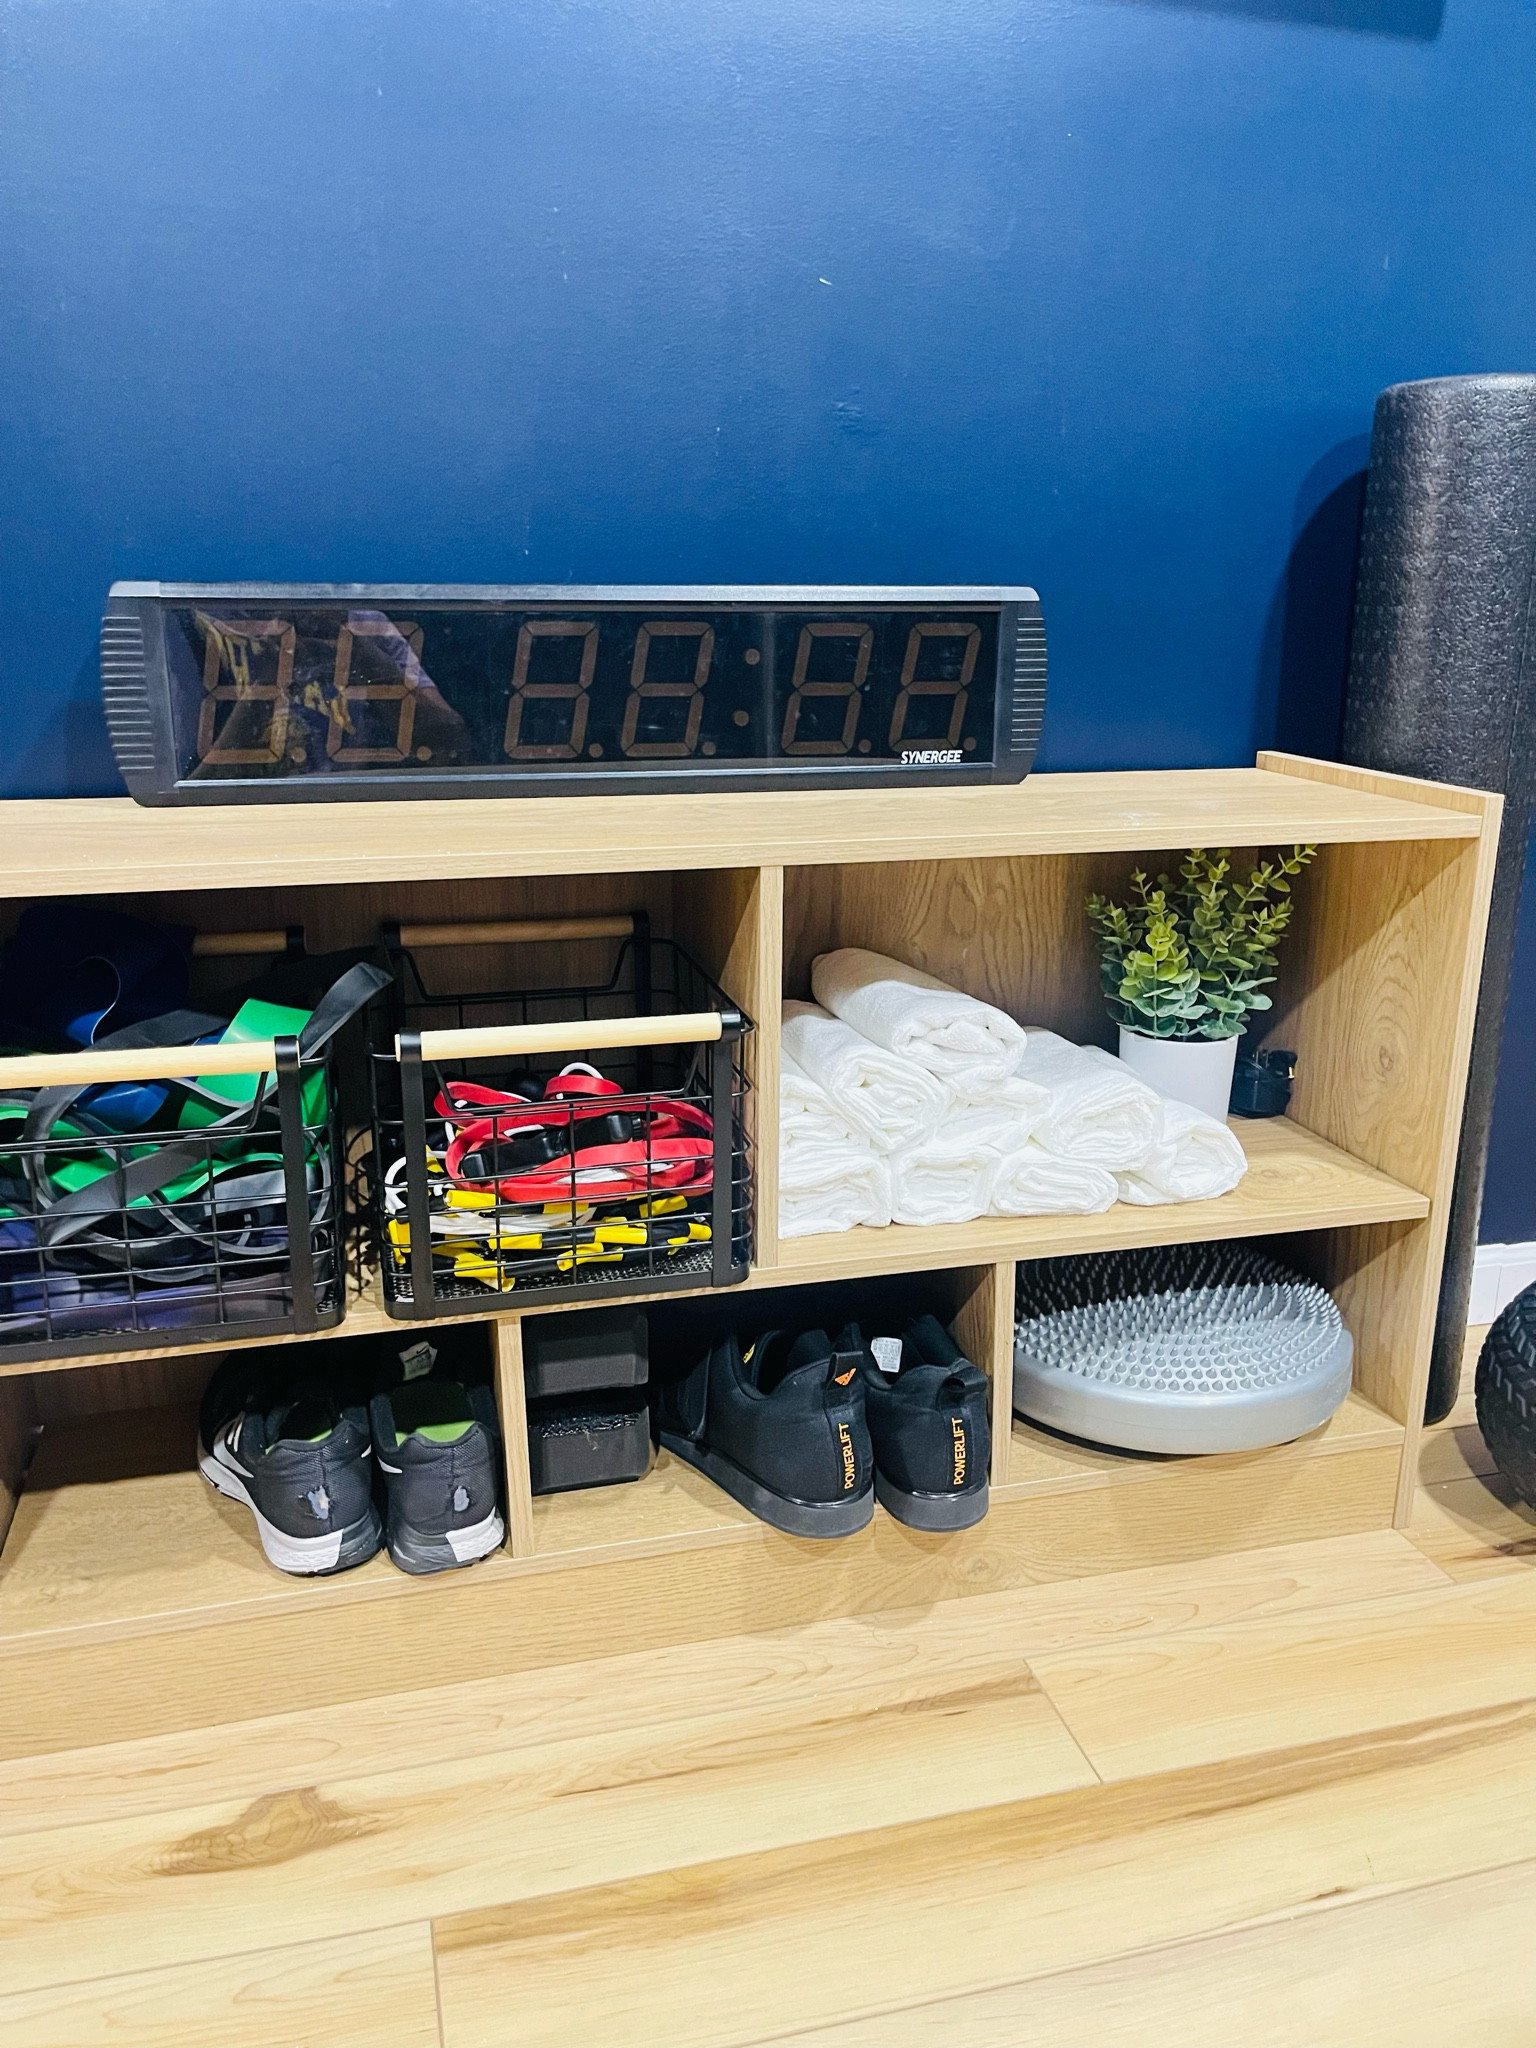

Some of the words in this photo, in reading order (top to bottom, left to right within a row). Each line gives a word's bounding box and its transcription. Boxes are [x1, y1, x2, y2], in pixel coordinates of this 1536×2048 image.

[900, 749, 963, 764] SYNERGEE
[838, 1422, 856, 1490] POWERLIFT
[951, 1417, 966, 1486] POWERLIFT
